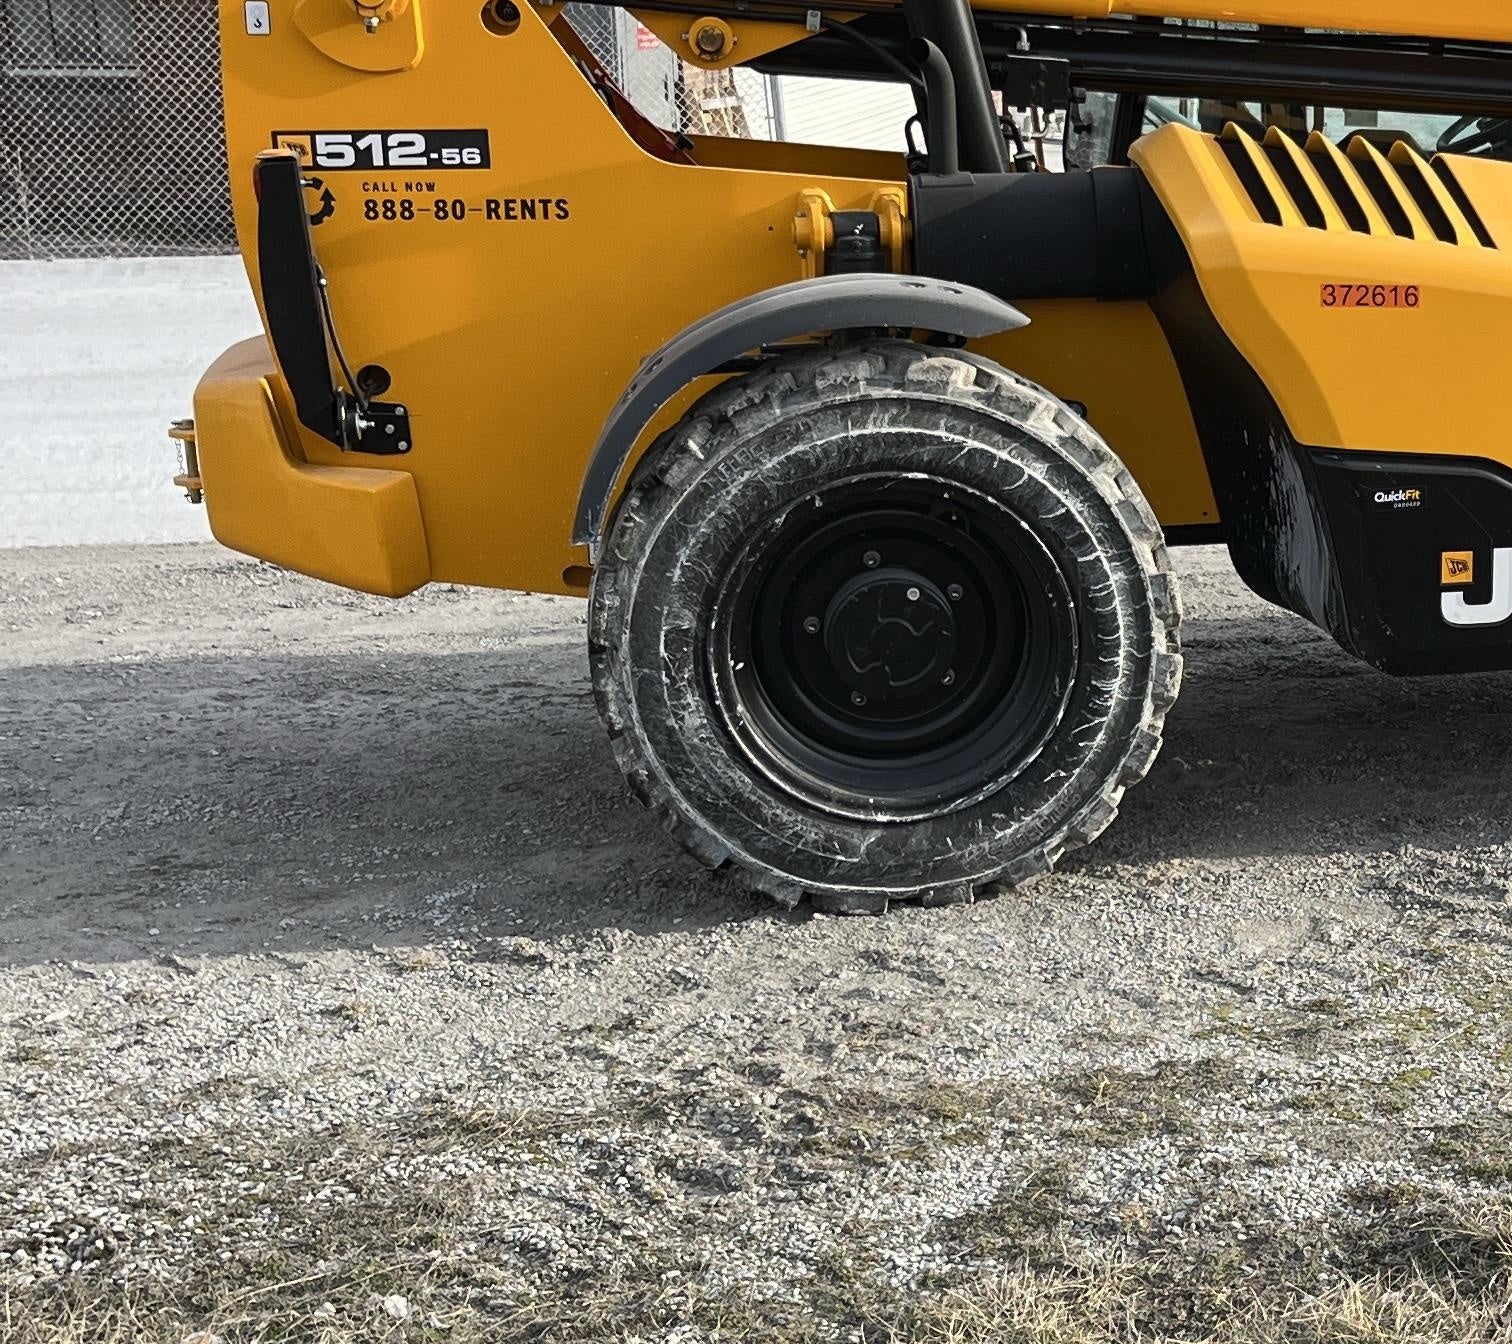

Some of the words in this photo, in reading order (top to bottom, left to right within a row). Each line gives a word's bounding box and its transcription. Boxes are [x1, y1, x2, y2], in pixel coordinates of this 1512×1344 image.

[315, 133, 482, 167] 512-56
[362, 181, 399, 193] CALL
[404, 181, 436, 193] NOW
[364, 198, 570, 221] 888-80-RENTS
[1322, 284, 1419, 307] 372616
[1374, 489, 1421, 503] QuickFit
